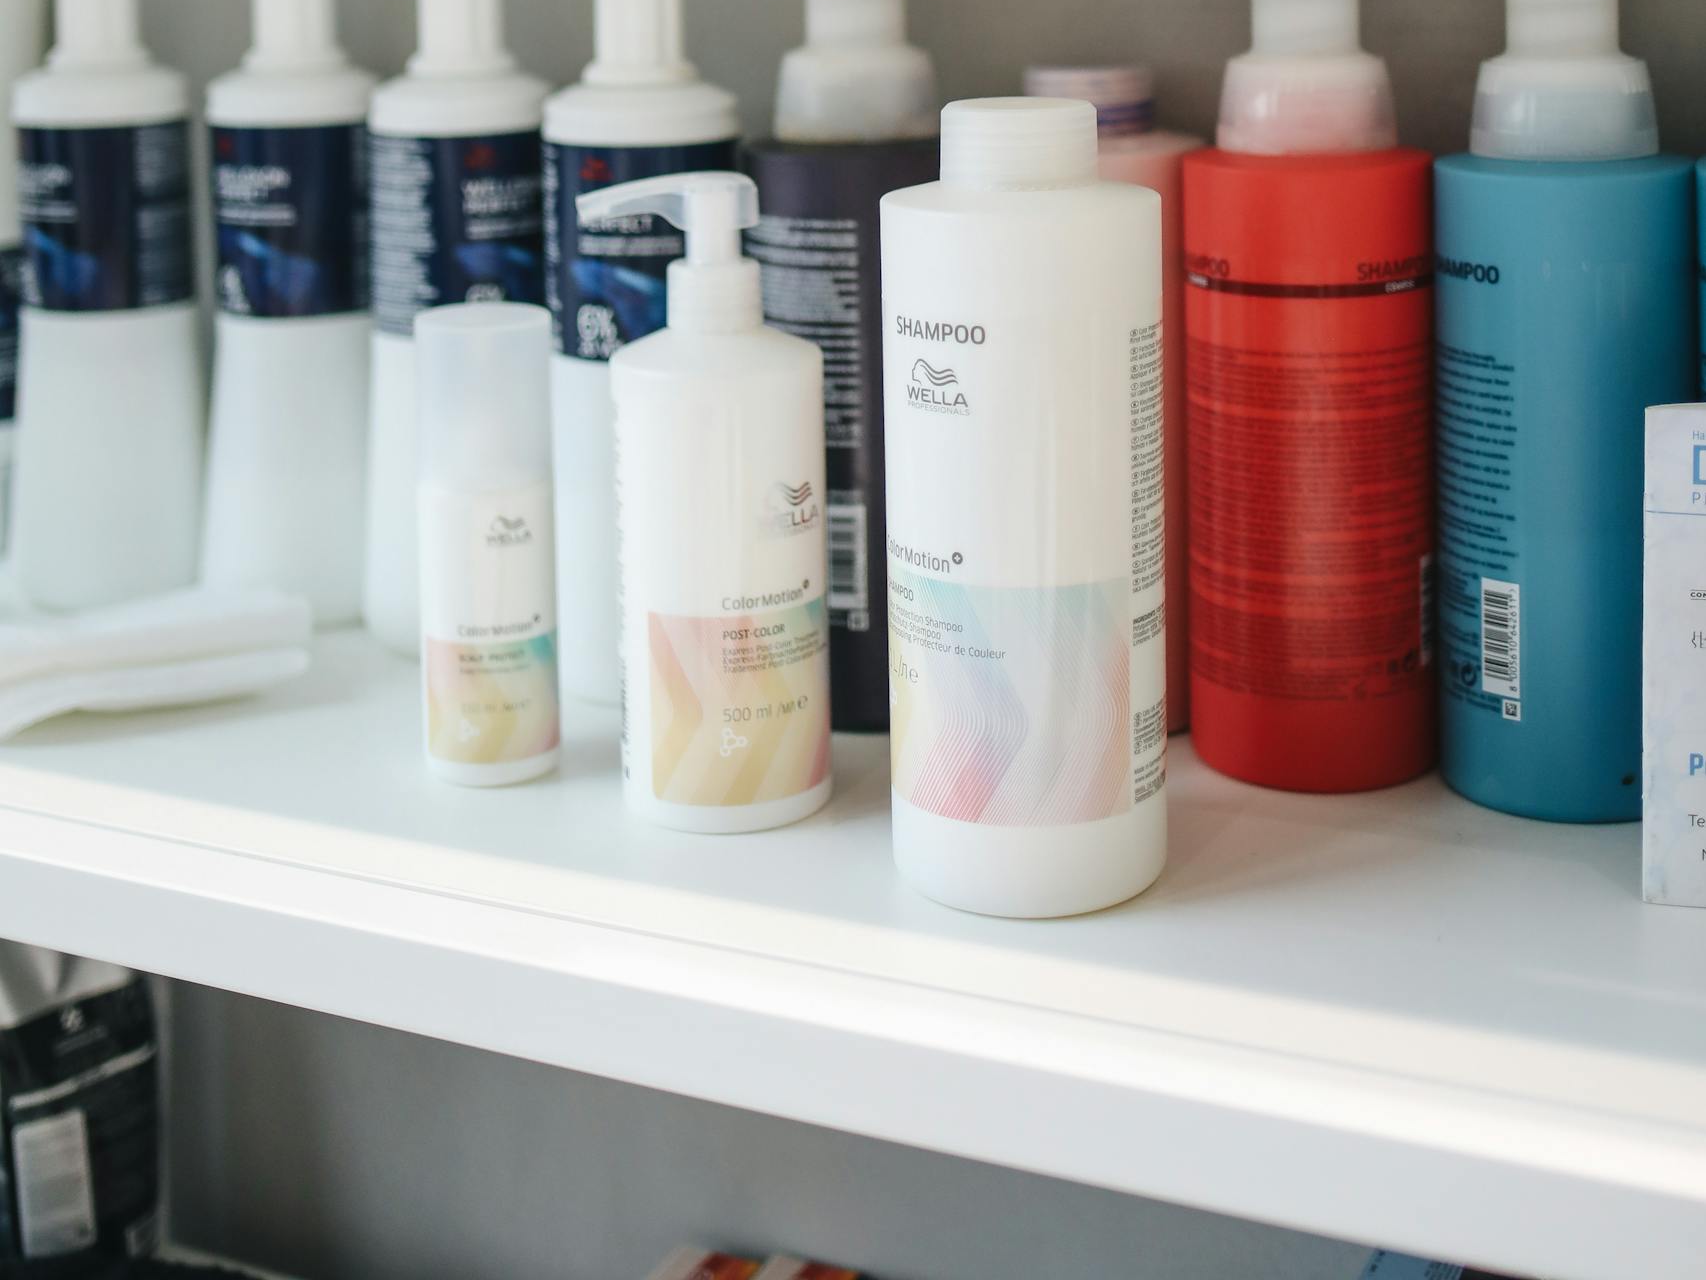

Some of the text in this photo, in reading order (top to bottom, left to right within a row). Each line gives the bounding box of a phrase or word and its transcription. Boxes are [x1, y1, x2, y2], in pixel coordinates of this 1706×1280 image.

[896, 314, 987, 346] SHAMPOO
[906, 384, 969, 408] WELLA
[907, 400, 971, 416] PROFESSIONALS
[721, 587, 804, 611] ColorMotion
[925, 615, 964, 633] Shampoo
[913, 634, 952, 653] Protecteur
[954, 645, 966, 656] de
[968, 646, 1007, 660] Couleur
[722, 706, 752, 722] 500
[756, 703, 772, 719] ml
[1690, 752, 1706, 776] P
